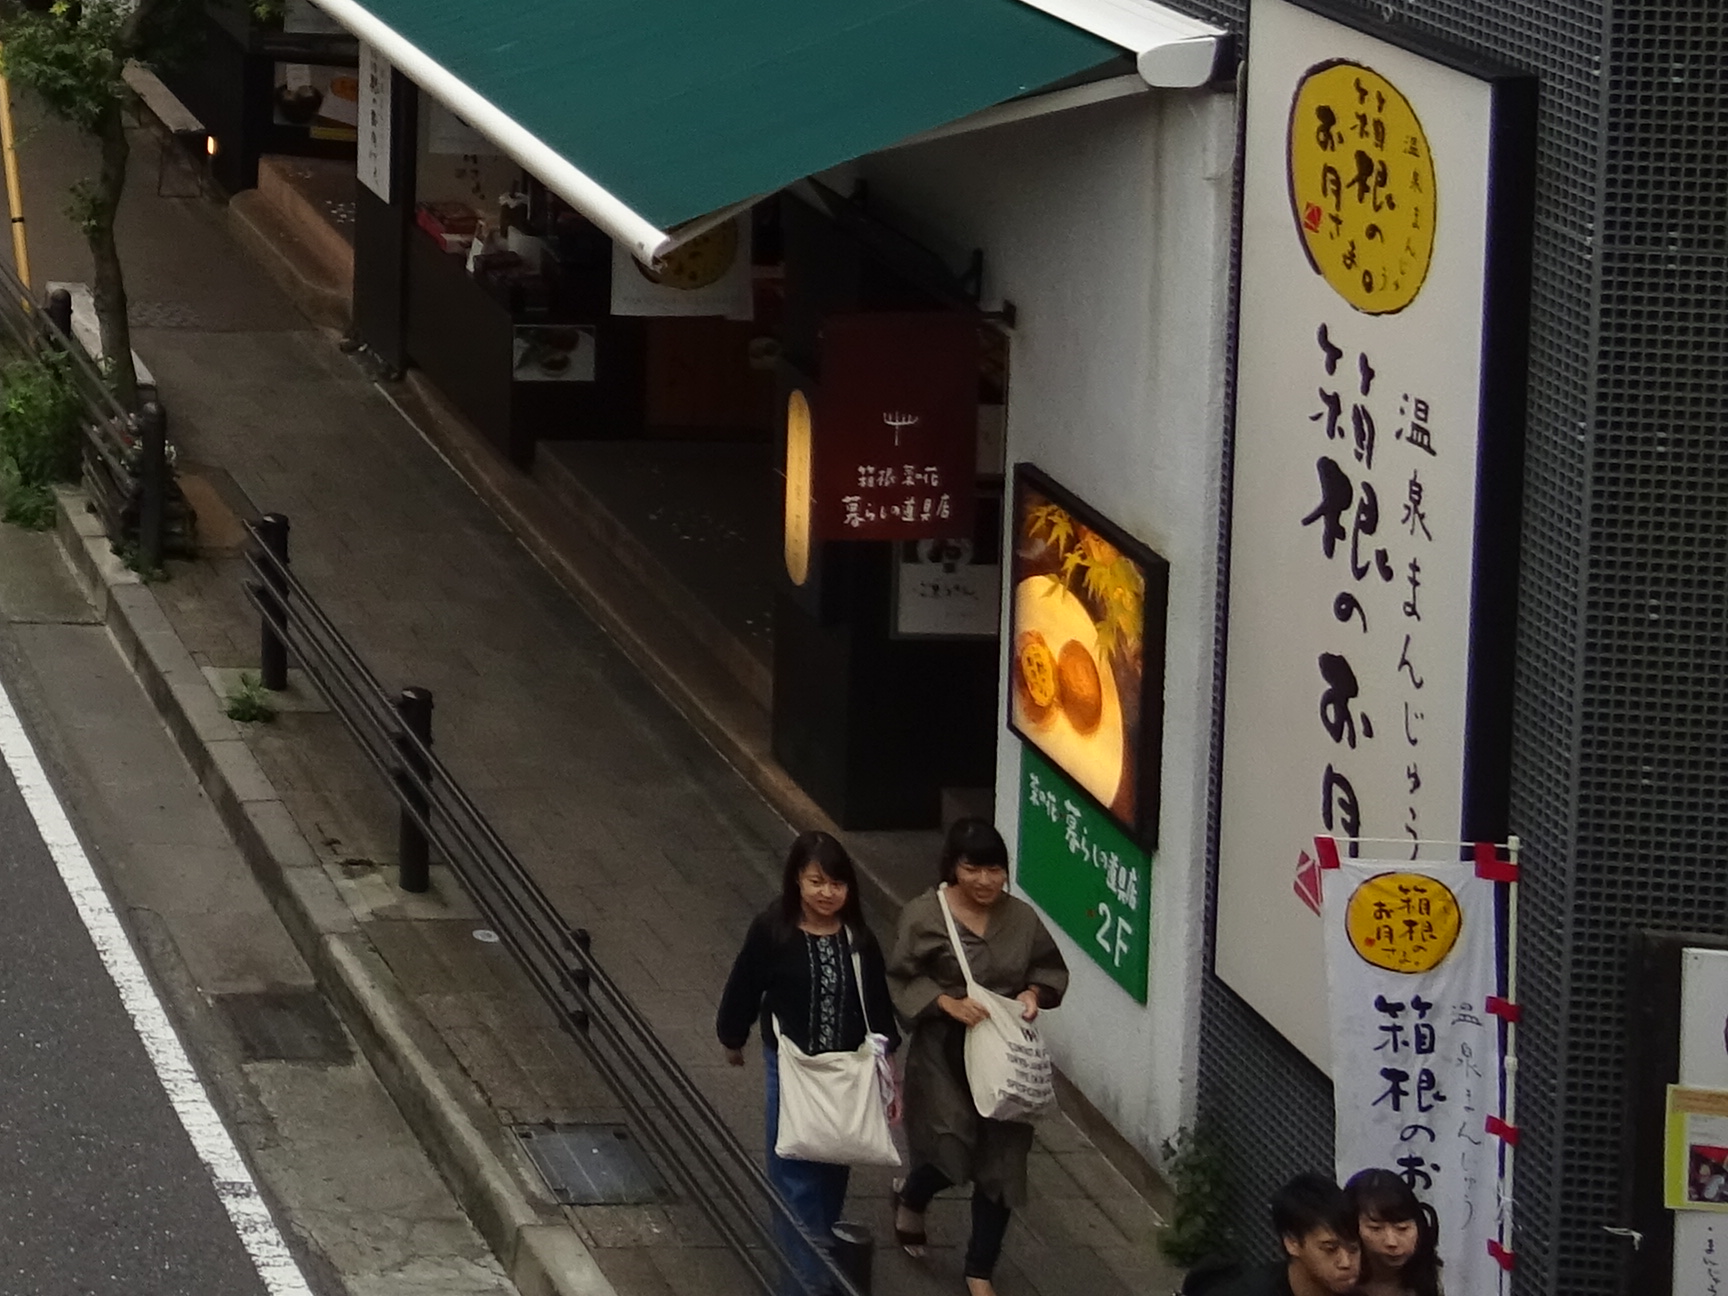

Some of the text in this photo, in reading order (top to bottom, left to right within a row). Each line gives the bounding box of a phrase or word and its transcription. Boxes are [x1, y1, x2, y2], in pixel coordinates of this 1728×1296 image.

[841, 492, 950, 528] 暮らしの道具店
[1063, 799, 1138, 911] 暮らしの道具店
[1095, 901, 1134, 968] 2F
